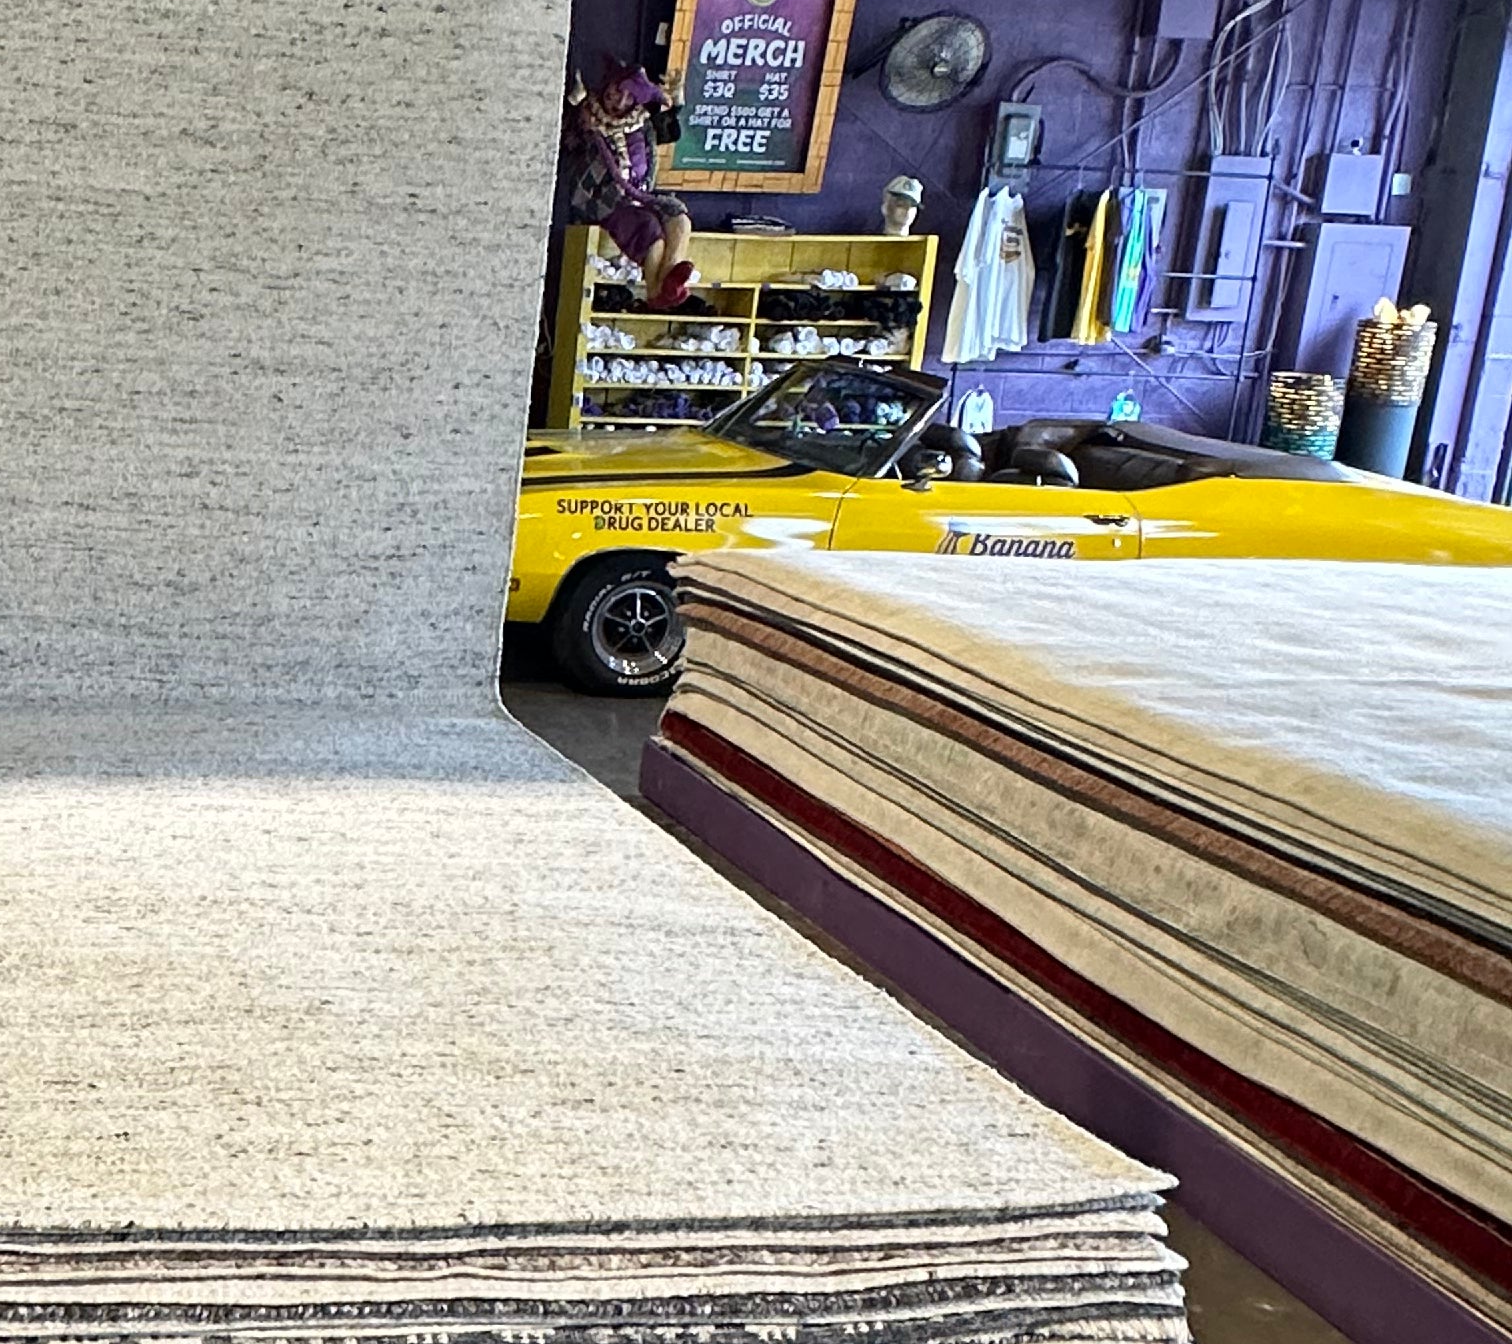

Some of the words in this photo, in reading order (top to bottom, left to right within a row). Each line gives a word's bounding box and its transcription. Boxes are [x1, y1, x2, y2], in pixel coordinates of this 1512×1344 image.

[720, 13, 792, 36] OFFICIAL
[699, 38, 806, 68] MERCH
[705, 69, 738, 81] SHIRT
[765, 72, 788, 83] HAT
[703, 81, 736, 98] $30
[759, 83, 789, 101] $35
[694, 104, 729, 116] SPEND
[757, 106, 781, 118] GET
[782, 107, 790, 118] A
[689, 115, 719, 126] SHIRT
[721, 116, 736, 127] OR
[738, 117, 746, 127] A
[748, 117, 770, 128] HAT
[771, 118, 792, 129] FOR
[704, 128, 771, 153] FREE
[556, 498, 635, 516] SUPPORT
[642, 501, 690, 517] YOUR
[694, 502, 754, 518] LOCAL
[593, 515, 643, 531] DRUG
[647, 517, 716, 533] DEALER
[969, 532, 1076, 559] Banana
